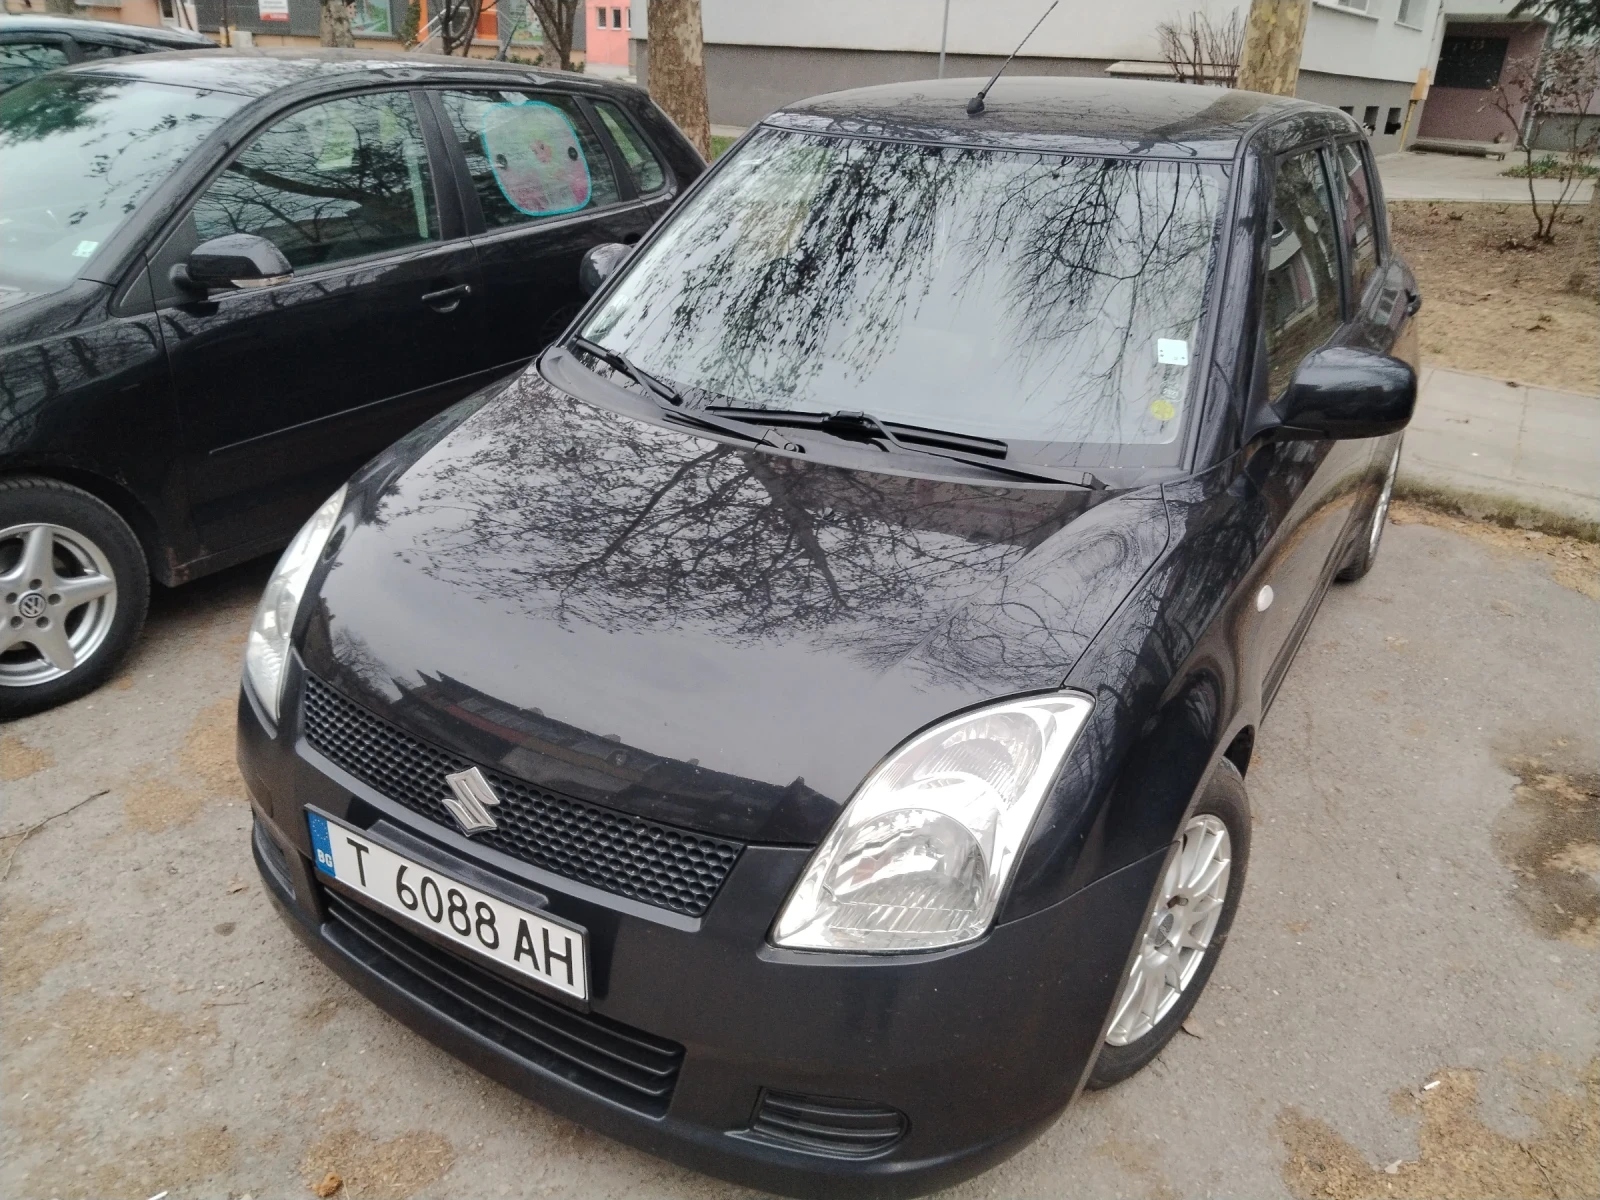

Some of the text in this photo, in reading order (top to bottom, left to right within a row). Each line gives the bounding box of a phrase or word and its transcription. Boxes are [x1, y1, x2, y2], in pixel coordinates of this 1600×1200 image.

[317, 848, 333, 868] BG
[346, 837, 574, 986] T 6088 AH
